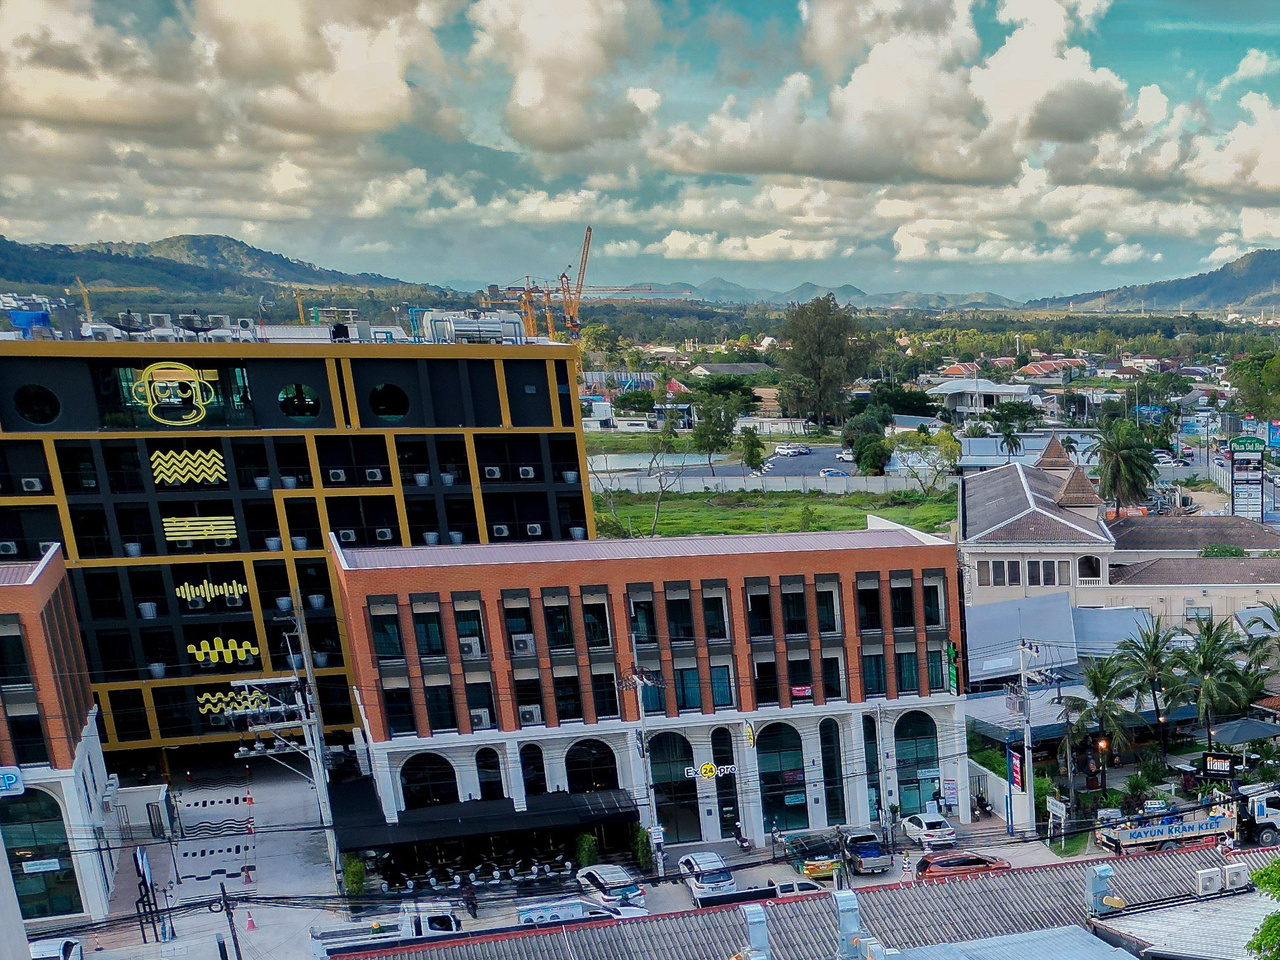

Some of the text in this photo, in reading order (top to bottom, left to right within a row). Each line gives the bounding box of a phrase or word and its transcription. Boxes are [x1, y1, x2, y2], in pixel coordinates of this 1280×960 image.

[1206, 756, 1230, 771] flame
[1129, 821, 1221, 840] KAYUN KRAN KIET
